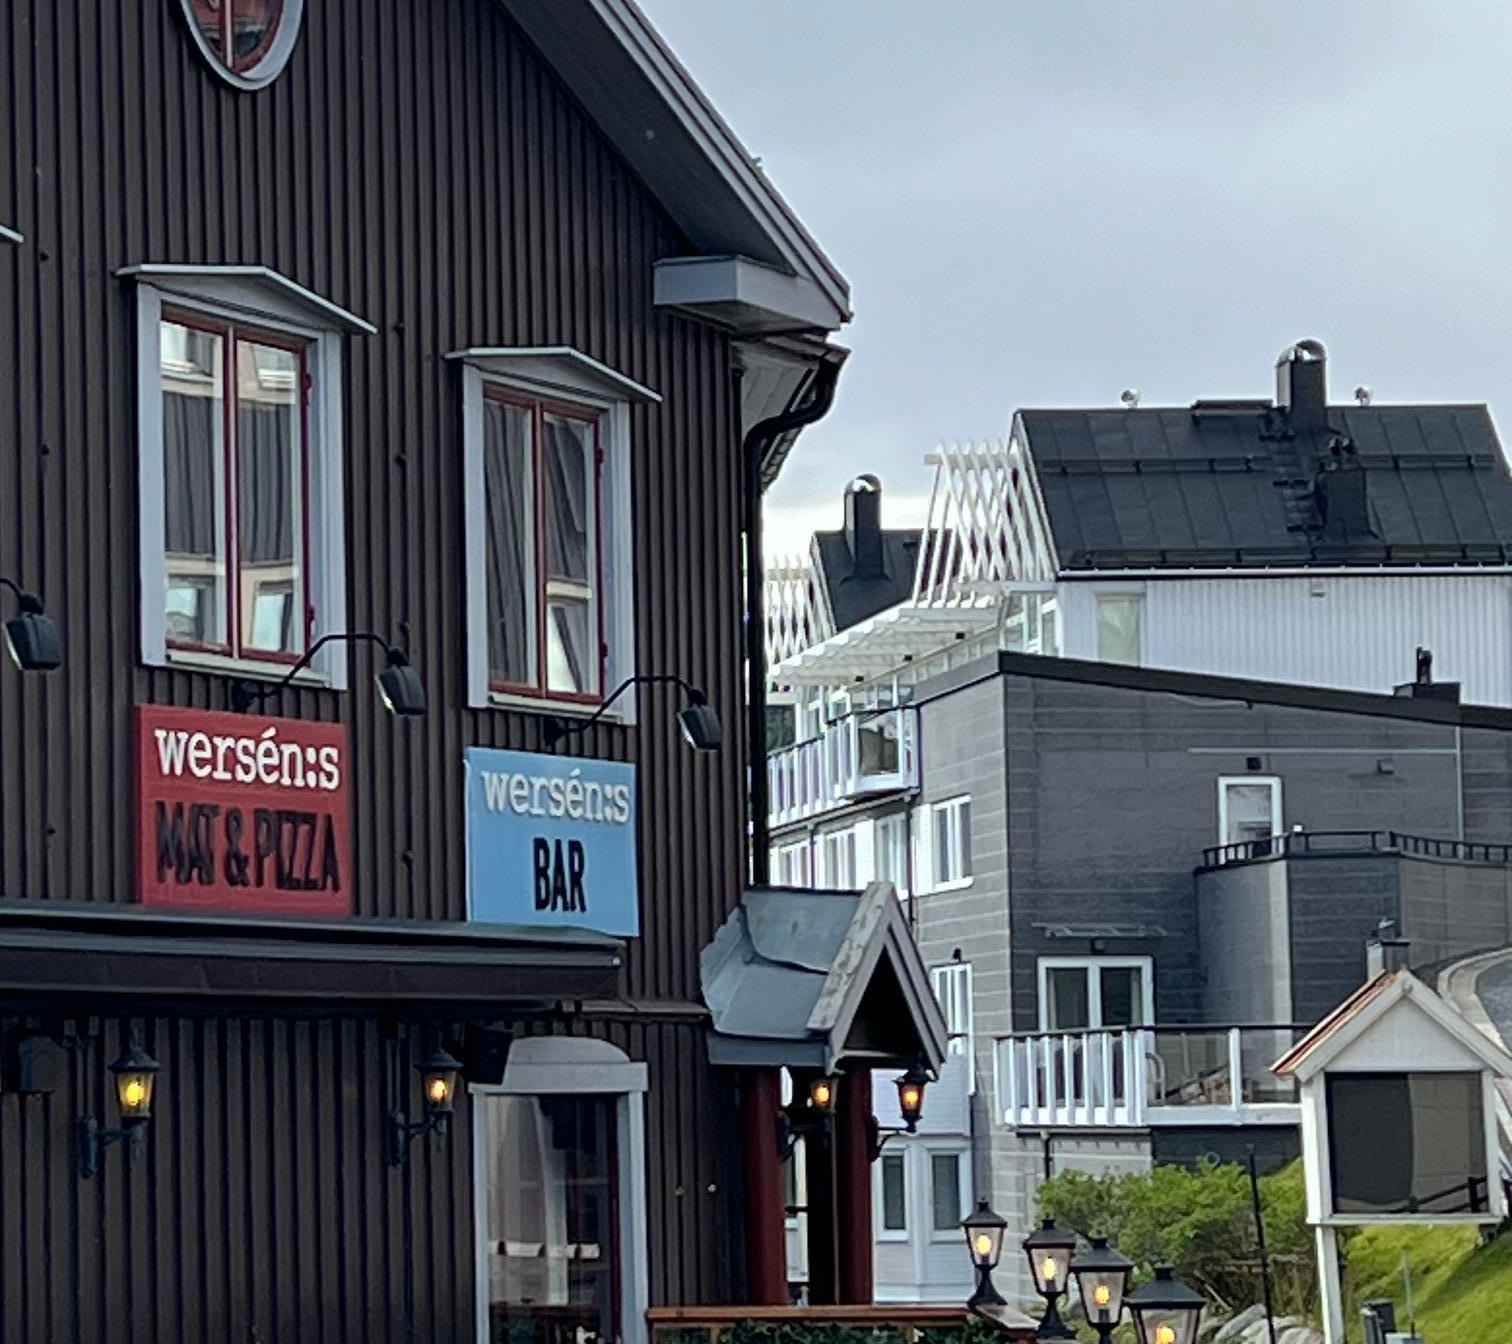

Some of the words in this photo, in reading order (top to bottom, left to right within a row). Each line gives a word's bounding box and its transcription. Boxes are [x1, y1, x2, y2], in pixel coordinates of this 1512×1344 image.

[154, 726, 340, 790] wersén:s
[481, 768, 630, 823] wersén:s
[156, 800, 220, 886] MAT
[225, 808, 249, 888] &
[254, 807, 341, 894] PIZZA
[533, 836, 587, 913] BAR
